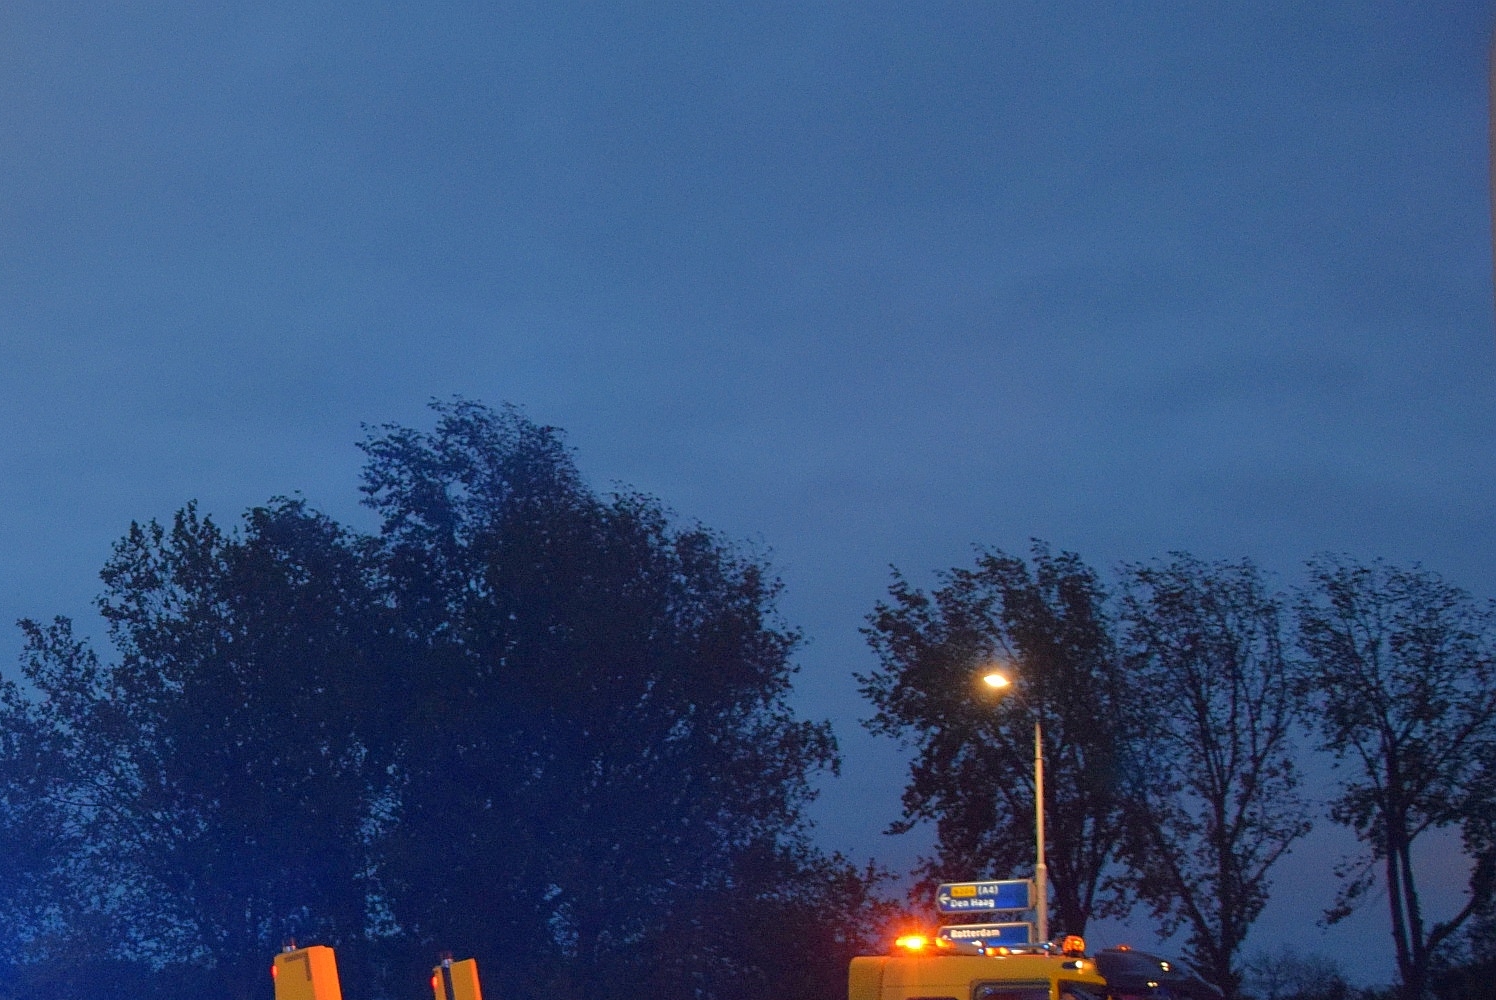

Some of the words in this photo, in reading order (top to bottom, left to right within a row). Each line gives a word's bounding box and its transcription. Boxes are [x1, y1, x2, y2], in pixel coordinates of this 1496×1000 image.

[950, 899, 969, 907] Den
[971, 898, 995, 908] Haag
[950, 929, 1001, 938] Rotterdam
